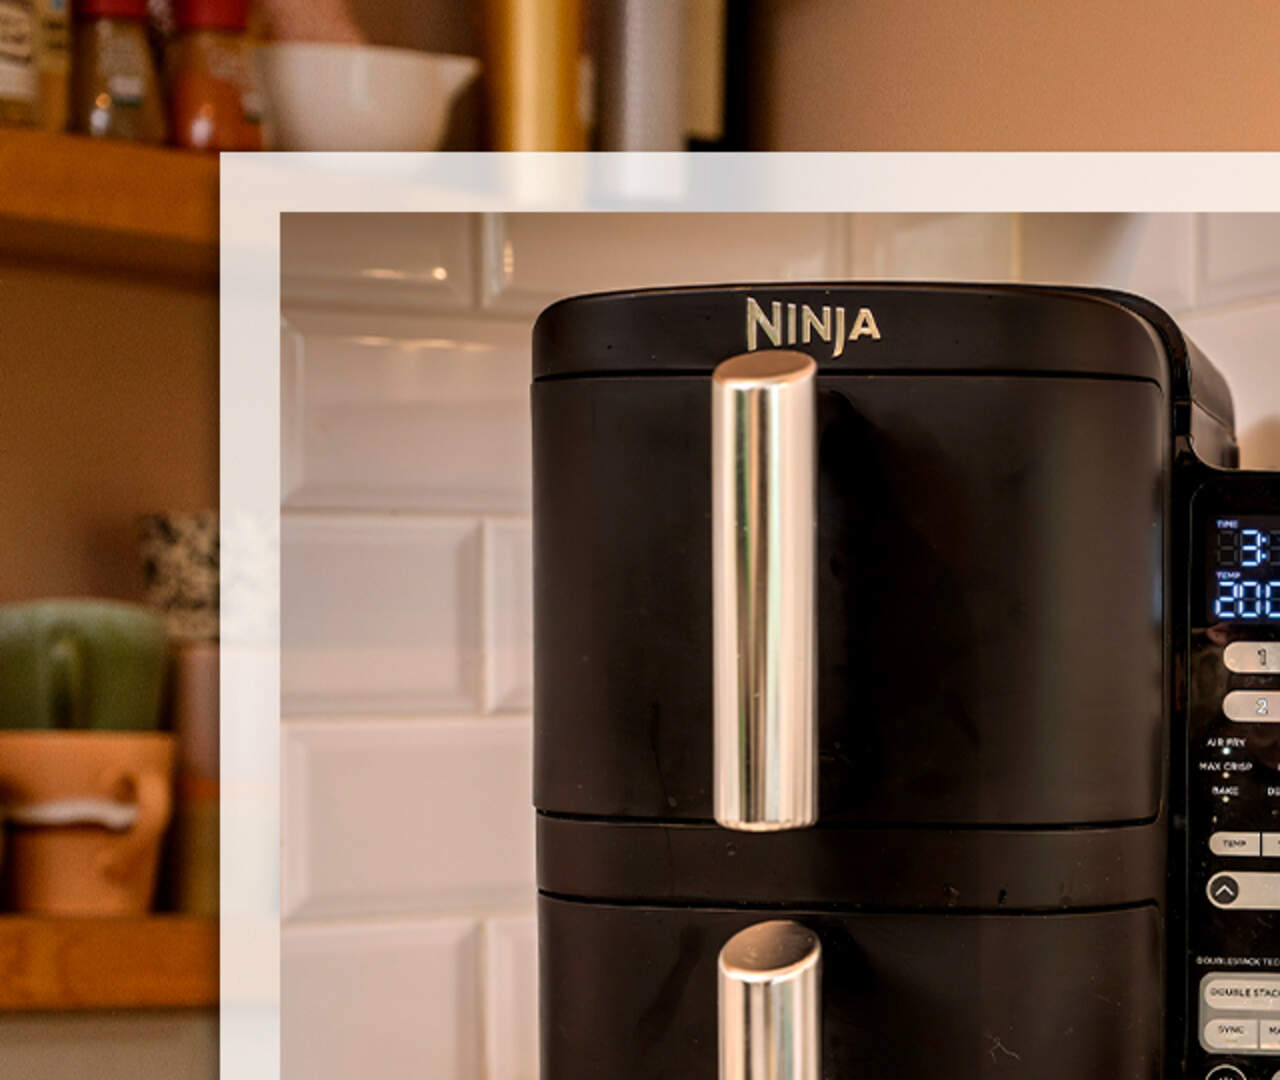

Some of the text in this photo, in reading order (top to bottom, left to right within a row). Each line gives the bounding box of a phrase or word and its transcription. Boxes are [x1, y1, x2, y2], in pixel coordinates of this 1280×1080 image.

[746, 296, 881, 358] NINJA
[1216, 519, 1239, 529] TIME
[1216, 571, 1241, 580] TEMP
[1257, 648, 1267, 666] 1
[1255, 698, 1268, 715] 2
[1206, 737, 1247, 748] AIR FRY
[1199, 762, 1253, 772] MAX CRISP
[1211, 786, 1240, 796] BAKE
[1222, 839, 1247, 849] TEMP
[1209, 987, 1251, 998] DOUBLE
[1217, 1025, 1244, 1035] SYNC
